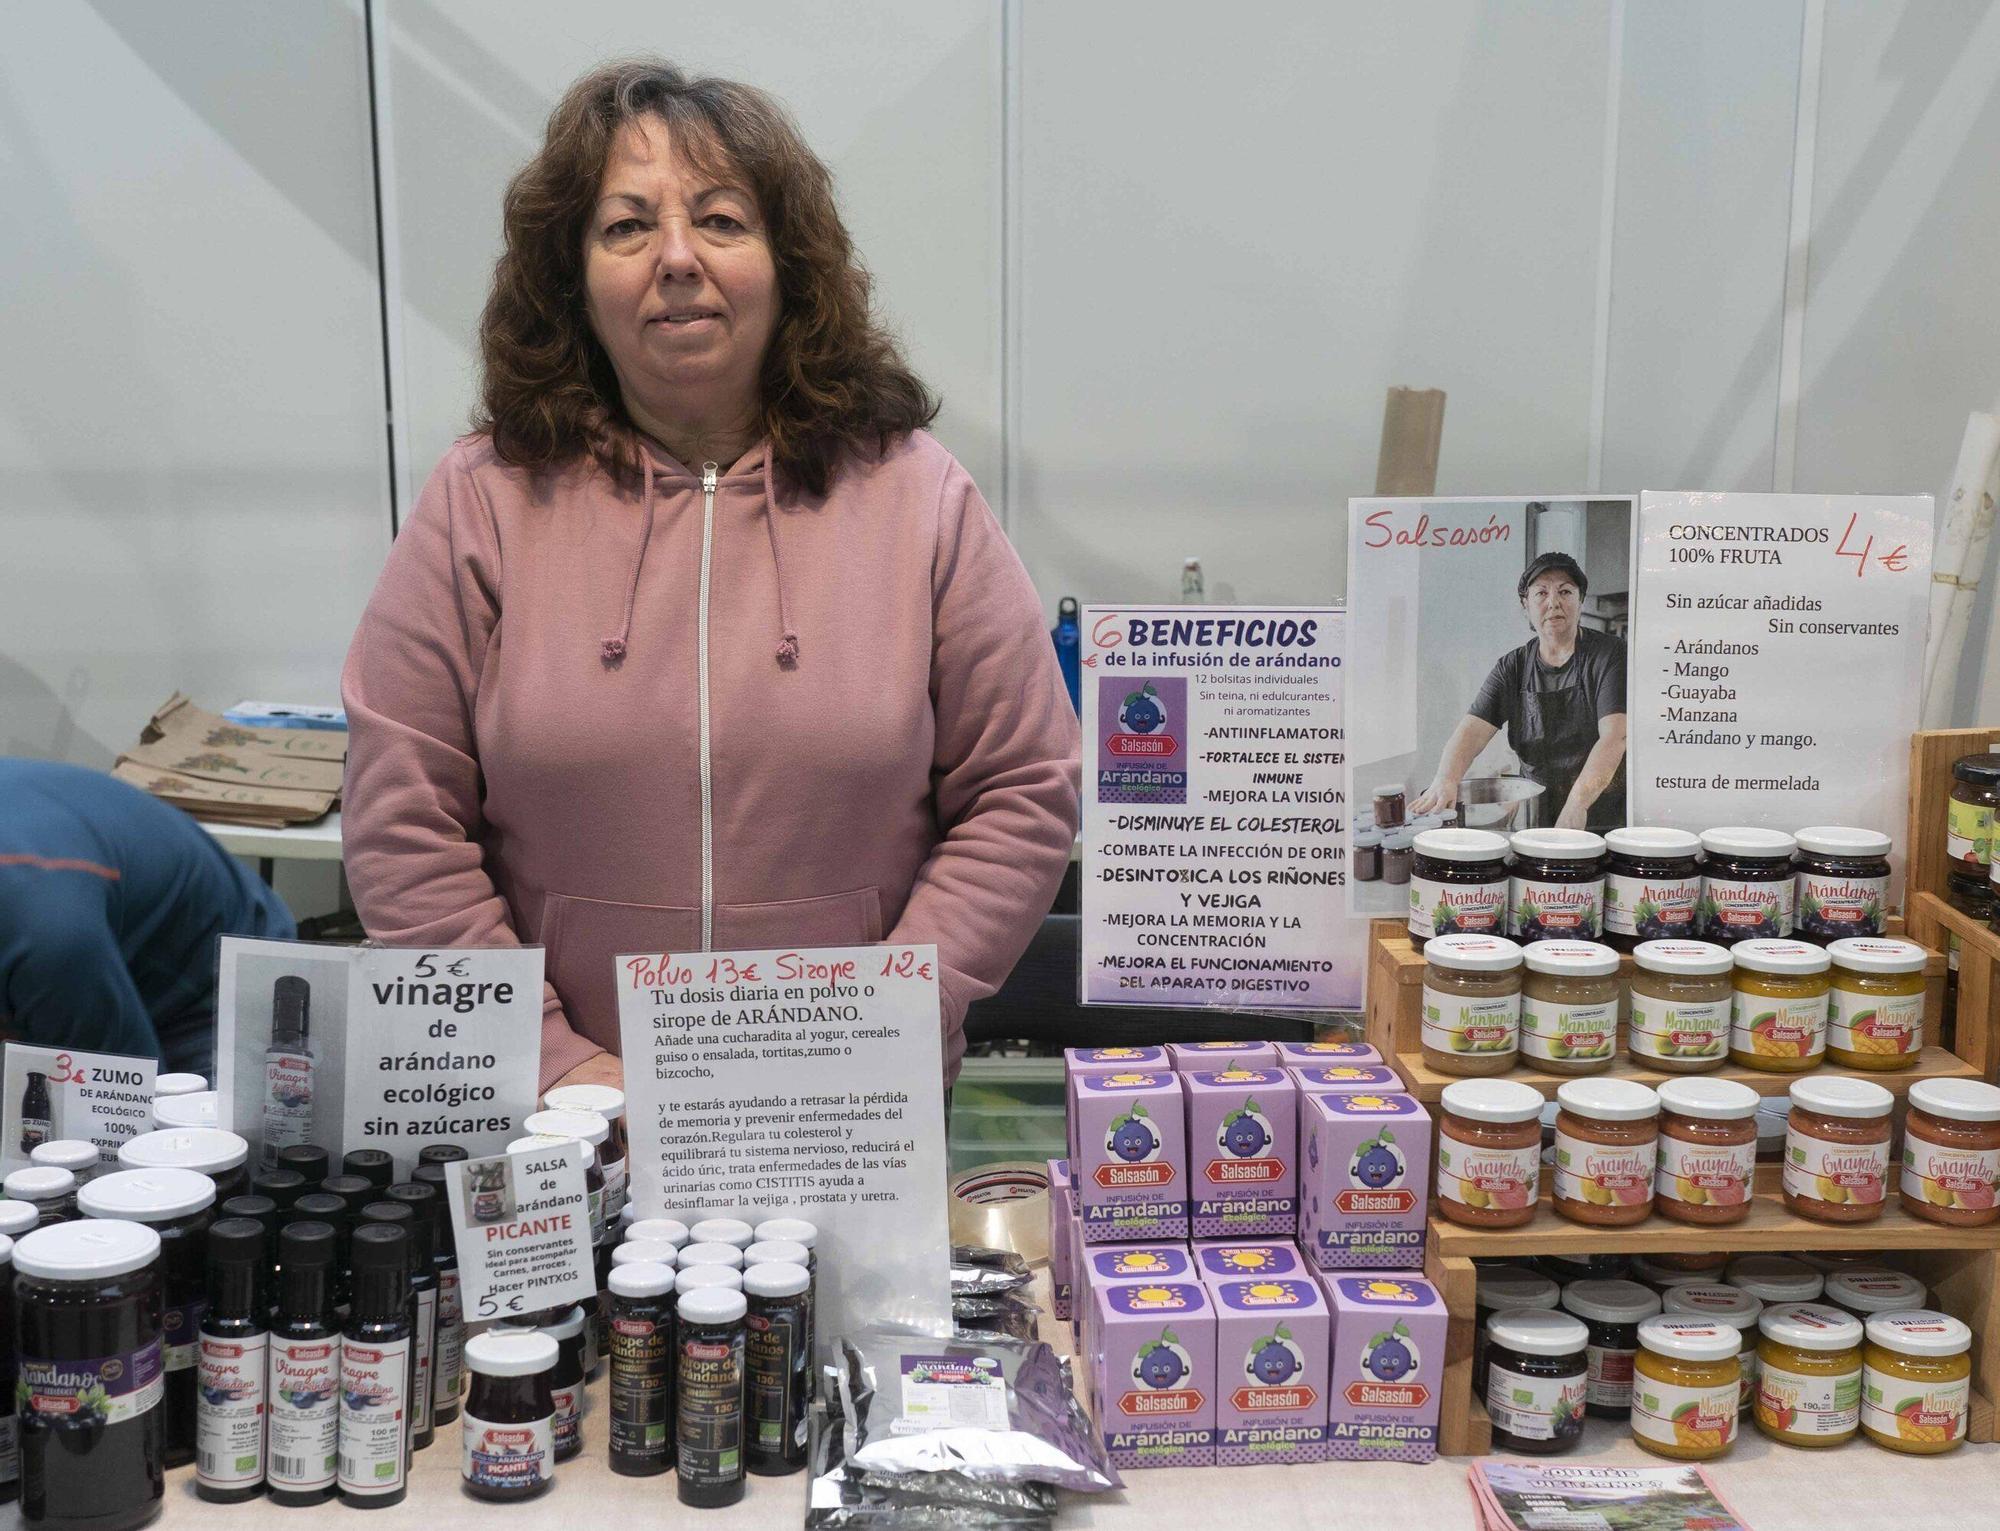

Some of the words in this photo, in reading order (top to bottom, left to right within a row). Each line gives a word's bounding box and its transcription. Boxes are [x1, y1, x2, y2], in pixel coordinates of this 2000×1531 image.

[1364, 511, 1510, 550] Salsasón
[1669, 525, 1829, 544] CONCENTRADOS
[1836, 512, 1873, 577] 4
[1878, 544, 1908, 572] €
[1669, 547, 1715, 565] 100%
[1720, 547, 1782, 566] FRUTA
[1666, 594, 1693, 611] Sin
[1698, 594, 1749, 612] azúcar
[1753, 595, 1822, 613] añadidas
[1092, 615, 1122, 648] 6
[1128, 619, 1318, 647] BENEFICIOS
[1768, 619, 1796, 634] Sin
[1799, 620, 1899, 636] conservantes
[1675, 639, 1759, 656] Arándanos
[1105, 653, 1126, 666] de
[1132, 653, 1147, 666] la
[1152, 653, 1224, 667] infusión
[1229, 653, 1250, 667] de
[1255, 653, 1341, 667] arándano
[1195, 675, 1207, 683] 12
[1211, 674, 1251, 684] bolsitas
[1254, 675, 1318, 684] individuales
[1674, 662, 1730, 681] Mango
[1661, 684, 1737, 704] -Guayaba
[1660, 707, 1738, 723] -Manzana
[1204, 728, 1345, 740] -ANTIINFLAMATORI
[1659, 729, 1741, 747] -Arándano
[1746, 734, 1755, 750] y
[1760, 733, 1817, 750] mango.
[1121, 739, 1163, 752] Salsasón
[1199, 753, 1279, 764] -FORTALECE
[1285, 753, 1299, 763] EL
[1101, 768, 1182, 783] Arándano
[1253, 773, 1302, 784] INMUNE
[1655, 774, 1707, 791] testura
[1711, 774, 1730, 791] de
[1735, 774, 1820, 792] mermelada
[1203, 791, 1267, 803] -MEJORA
[1272, 792, 1290, 803] LA
[1295, 789, 1345, 803] VISIÓN
[1109, 816, 1204, 832] -DISMINUYE
[1211, 818, 1232, 831] EL
[1238, 818, 1344, 834] COLESTEROL
[1098, 845, 1174, 856] -COMBATE
[1180, 846, 1197, 857] LA
[1202, 844, 1283, 858] INFECCIÓN
[1288, 847, 1306, 858] DE
[1096, 869, 1223, 883] -DESINTOXICA
[1229, 870, 1261, 883] LOS
[1267, 866, 1345, 886] RIÑONES
[1181, 894, 1191, 907] Y
[1198, 894, 1261, 908] VEJIGA
[1137, 933, 1266, 948] CONCENTRACIÓN
[415, 954, 438, 977] 5
[447, 957, 472, 976] €
[627, 954, 693, 989] Polvo
[1098, 956, 1166, 968] -MEJORA
[1171, 958, 1186, 969] EL
[1191, 958, 1332, 972] FUNCIONAMIENTO
[651, 988, 674, 1005] Tu
[680, 986, 725, 1003] dosis
[730, 984, 779, 1002] diaria
[784, 984, 804, 1000] en
[810, 981, 859, 999] polvo
[864, 984, 874, 997] o
[1120, 977, 1145, 987] DEL
[1151, 978, 1226, 990] APARATO
[1232, 979, 1310, 991] DIGESTIVO
[373, 977, 514, 1013] vinagre
[653, 1011, 706, 1031] sirope
[711, 1010, 731, 1026] de
[736, 1005, 864, 1025] ARÁNDANO.
[429, 1020, 457, 1037] de
[655, 1034, 693, 1047] Añade
[697, 1035, 719, 1045] una
[723, 1030, 792, 1043] cucharadita
[796, 1029, 806, 1040] al
[810, 1028, 849, 1042] yogur,
[852, 1027, 900, 1039] cereales
[380, 1052, 496, 1071] arándano
[656, 1050, 688, 1065] guiso
[692, 1052, 699, 1061] o
[703, 1048, 759, 1062] ensalada,
[762, 1046, 841, 1058] tortitas,zumo
[844, 1046, 852, 1055] o
[92, 1068, 143, 1086] ZUMO
[656, 1066, 714, 1079] bizcocho,
[80, 1088, 94, 1099] DE
[384, 1084, 495, 1106] ecológico
[92, 1104, 146, 1118] ECOLÓGICO
[658, 1102, 666, 1114] y
[669, 1101, 680, 1111] te
[684, 1098, 725, 1111] estarás
[729, 1096, 787, 1111] ayudando
[790, 1098, 797, 1107] a
[801, 1093, 845, 1106] retrasar
[849, 1093, 860, 1104] la
[863, 1092, 908, 1106] pérdida
[104, 1122, 138, 1135] 100%
[364, 1117, 399, 1135] sin
[407, 1117, 511, 1135] azúcares
[660, 1130, 765, 1145] corazón.Regulara
[769, 1128, 780, 1140] tu
[784, 1126, 842, 1139] colesterol
[846, 1127, 853, 1140] y
[526, 1158, 568, 1174] SALSA
[1221, 1161, 1270, 1179] Salsasón
[1822, 1152, 1882, 1178] Guayaba
[1929, 1154, 1993, 1181] Guayaba
[663, 1180, 716, 1194] urinarias
[720, 1180, 753, 1191] como
[756, 1175, 815, 1189] CISTITIS
[819, 1175, 854, 1189] ayuda
[858, 1176, 864, 1185] a
[1110, 1168, 1159, 1184] Salsasón
[540, 1180, 556, 1191] de
[517, 1194, 583, 1213] arándano
[1090, 1203, 1182, 1219] Arándano
[1200, 1198, 1291, 1214] Arándano
[1351, 1194, 1400, 1210] Salsasón
[486, 1214, 572, 1242] PICANTE
[1327, 1228, 1419, 1245] Arándano
[488, 1250, 503, 1259] Sin
[505, 1237, 573, 1256] conservantes
[489, 1281, 524, 1294] Hacer
[528, 1271, 579, 1289] PINTXOS
[479, 1293, 498, 1316] 5
[506, 1296, 524, 1311] €
[1136, 1395, 1188, 1411] Salsasón
[1248, 1389, 1300, 1407] Salsasón
[1362, 1387, 1412, 1404] Salsasón
[1923, 1392, 1965, 1419] Mango
[1112, 1430, 1210, 1447] Arándano
[1224, 1425, 1322, 1442] Arándano
[1335, 1420, 1432, 1439] Arándano
